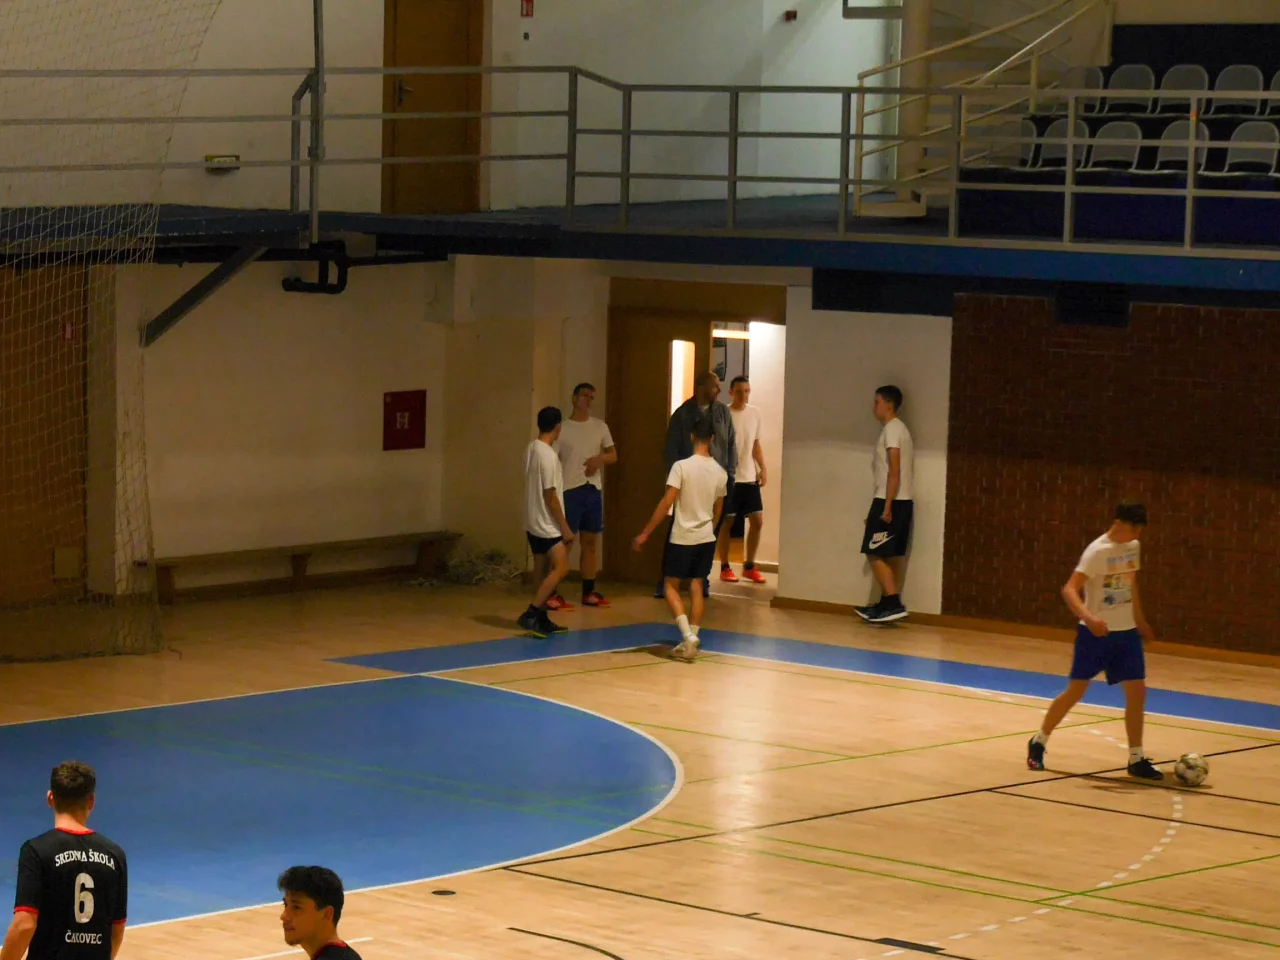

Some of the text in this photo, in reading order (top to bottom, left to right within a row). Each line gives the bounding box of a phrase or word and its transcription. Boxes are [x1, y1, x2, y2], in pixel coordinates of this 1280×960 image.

[88, 848, 116, 871] ŠKOLA
[74, 872, 95, 924] 6
[65, 929, 103, 945] ČAKOVEC
